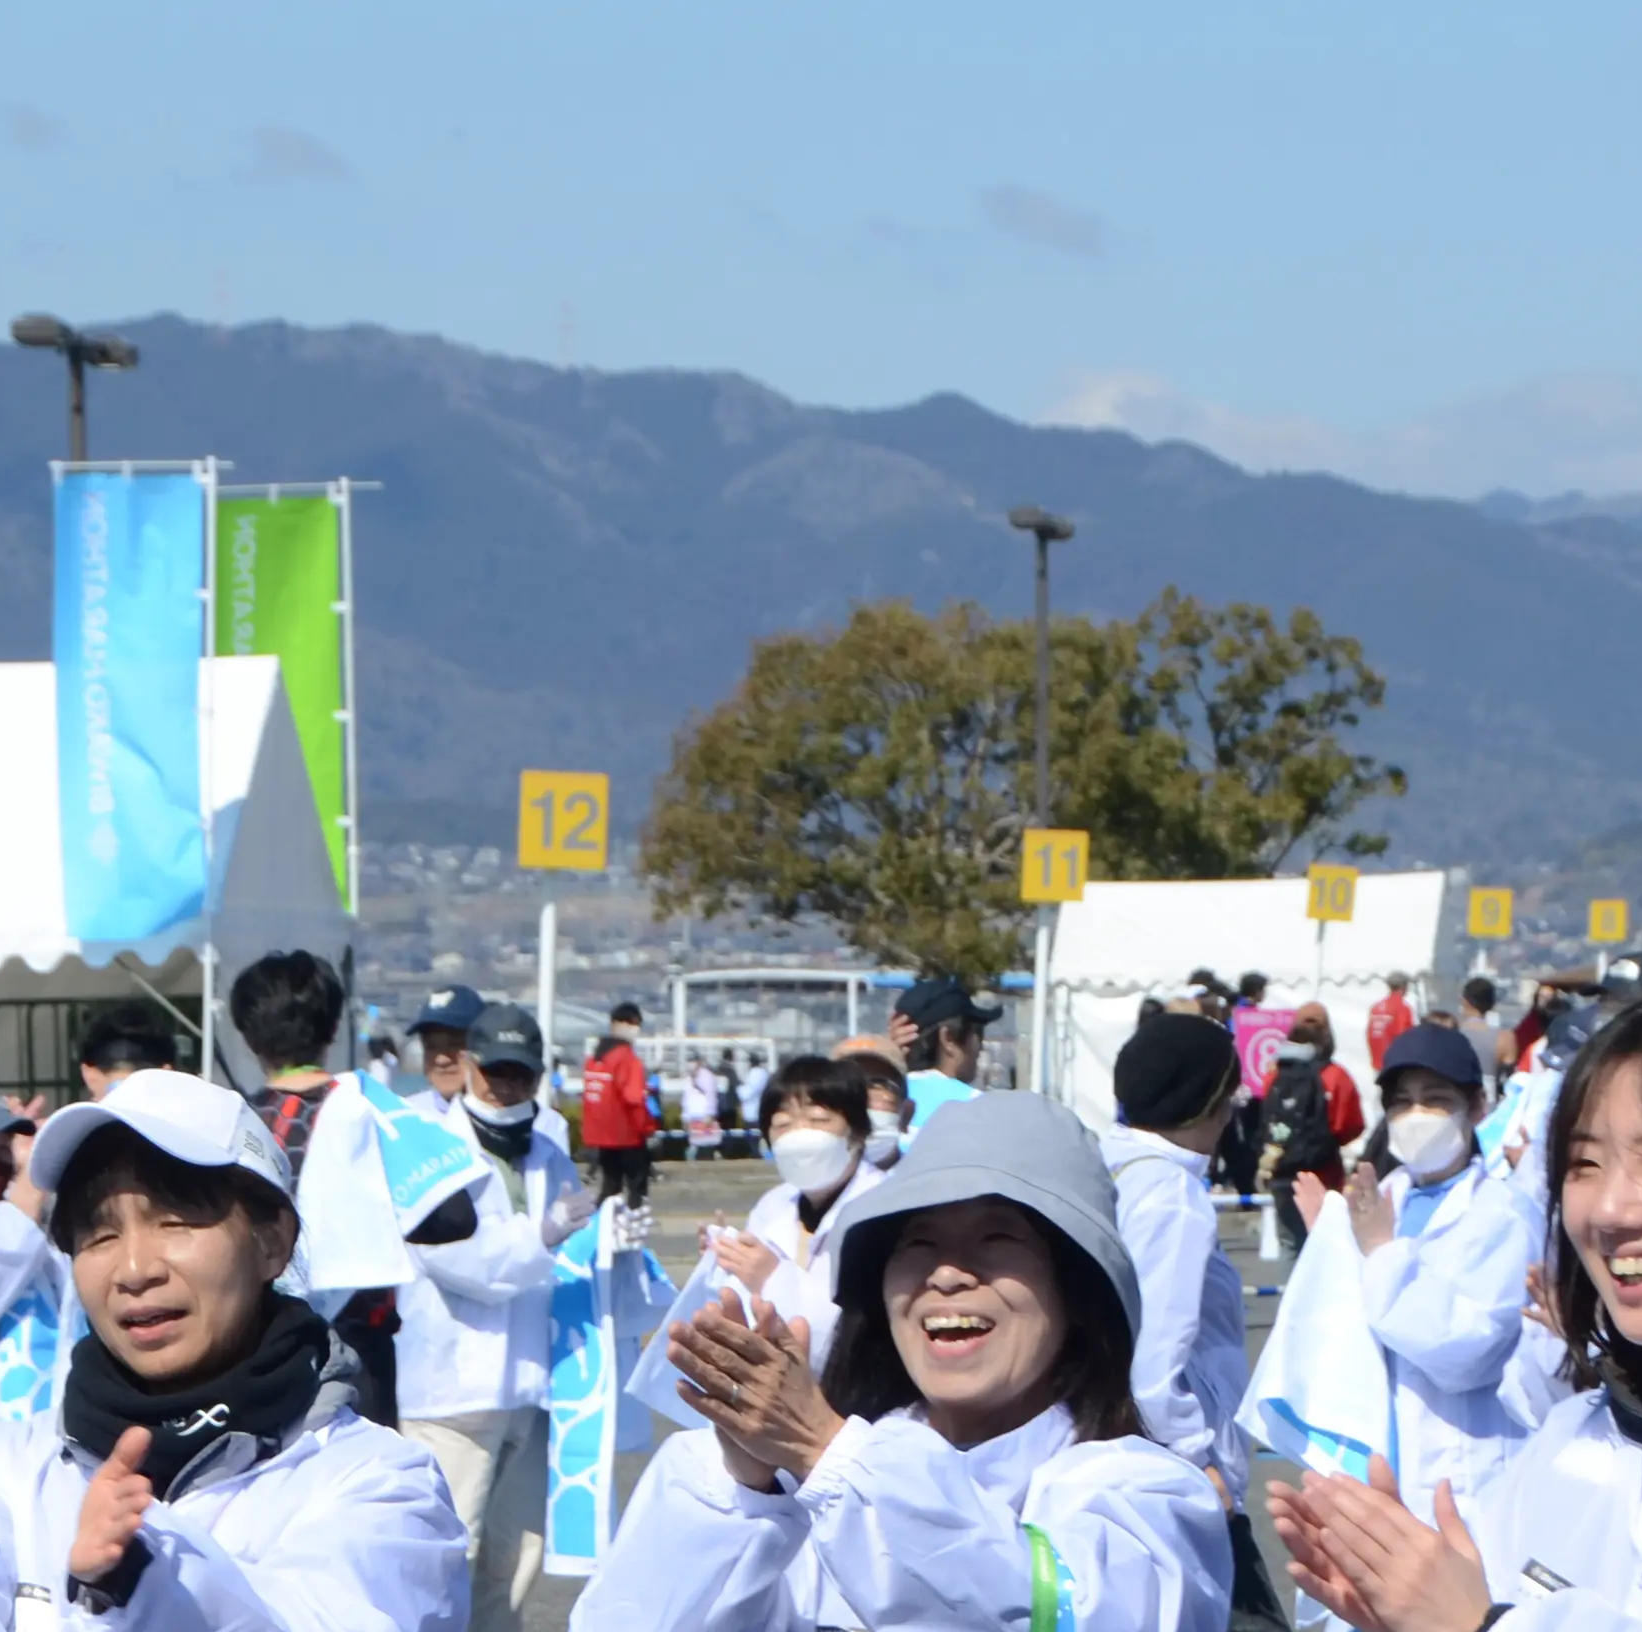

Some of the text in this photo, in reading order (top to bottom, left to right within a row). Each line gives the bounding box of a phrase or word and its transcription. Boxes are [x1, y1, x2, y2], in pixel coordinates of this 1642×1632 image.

[530, 790, 600, 850] 12
[1034, 843, 1080, 889] 11
[1316, 876, 1352, 913] 10
[1481, 897, 1500, 926] 9
